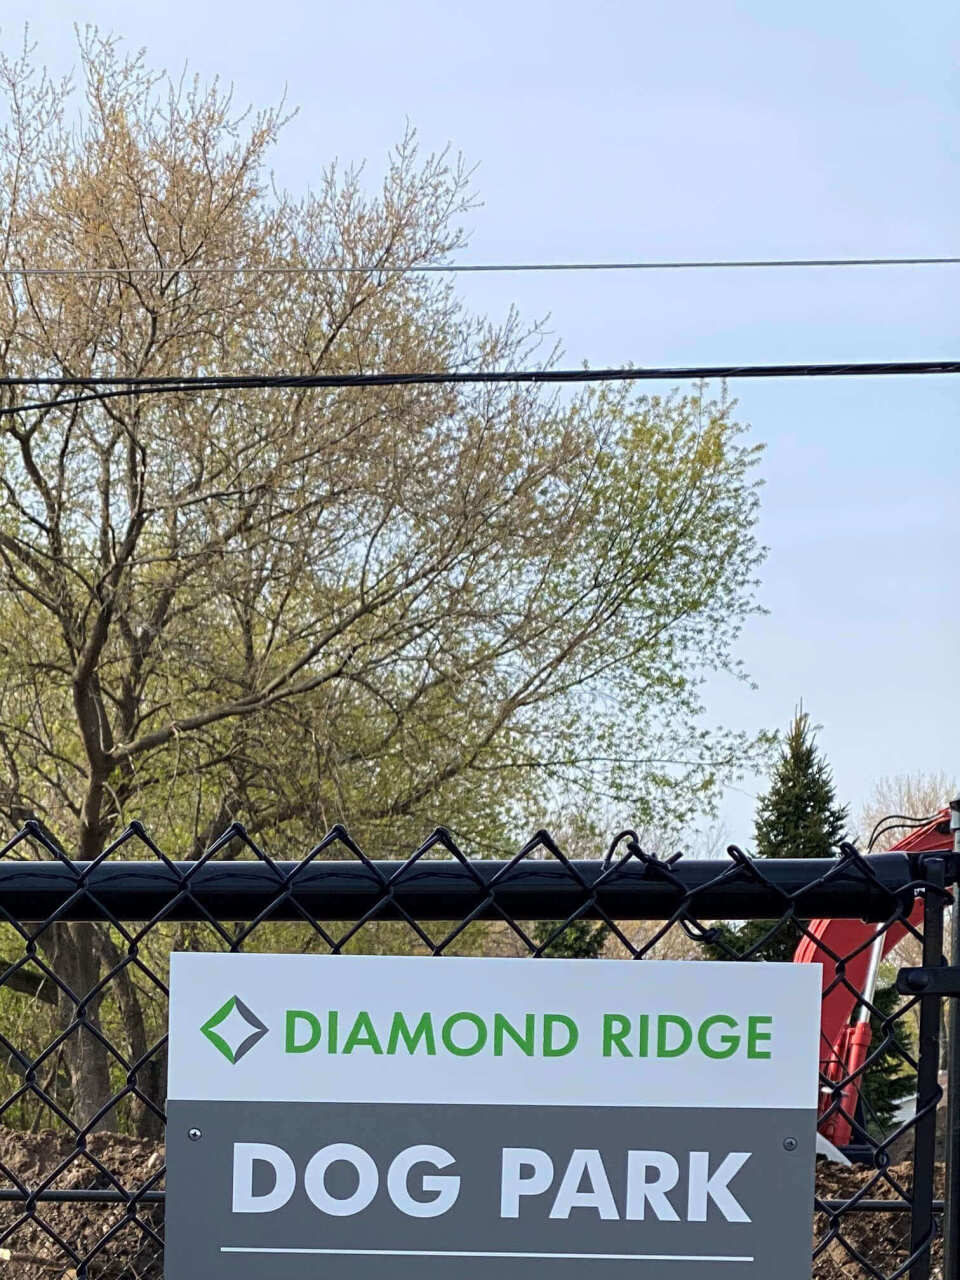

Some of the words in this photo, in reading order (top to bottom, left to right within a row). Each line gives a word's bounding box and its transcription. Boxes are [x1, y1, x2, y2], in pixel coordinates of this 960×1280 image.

[285, 1010, 579, 1057] DIAMOND
[603, 1014, 773, 1059] RIDGE
[232, 1142, 461, 1218] DOG
[500, 1147, 752, 1223] PARK
